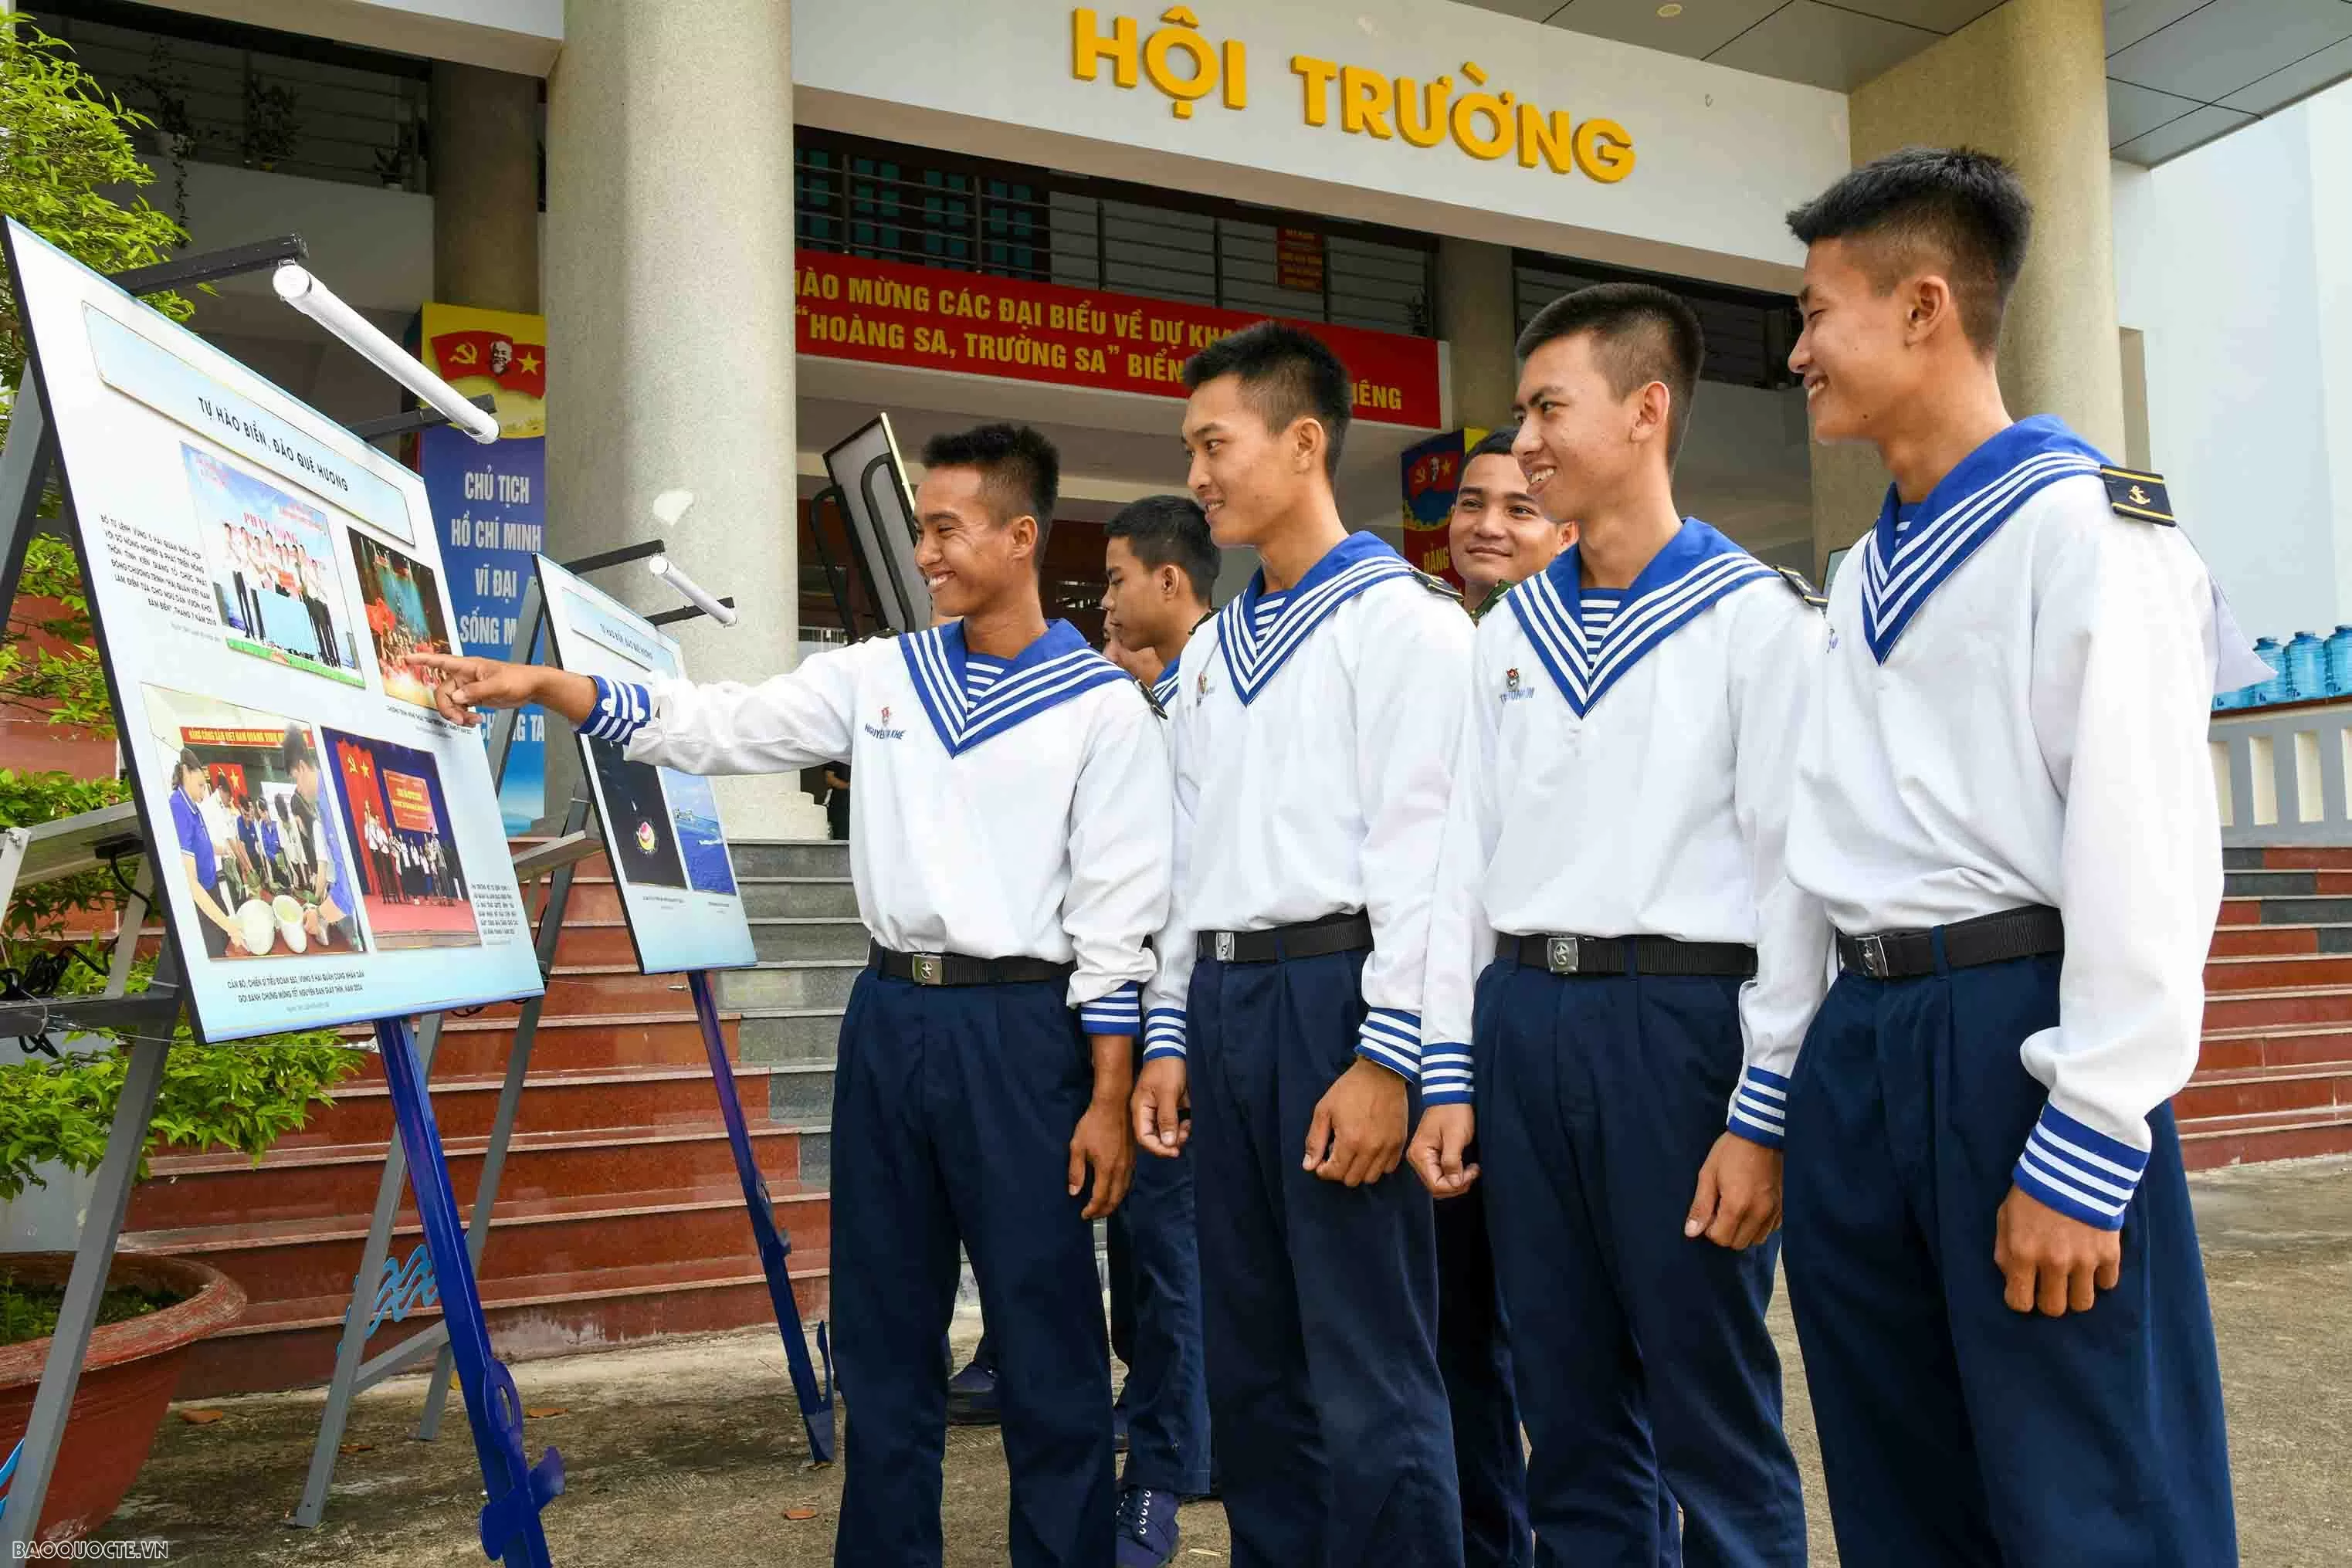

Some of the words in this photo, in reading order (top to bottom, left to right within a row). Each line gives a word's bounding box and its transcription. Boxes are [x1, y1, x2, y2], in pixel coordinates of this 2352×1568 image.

[1072, 5, 1245, 118] HỘI
[1290, 55, 1635, 184] TRƯỜNG
[795, 266, 839, 300] ÀO
[849, 276, 930, 312] MỪNG
[938, 288, 990, 320] CÁC
[999, 297, 1042, 330] ĐẠI
[1049, 300, 1107, 334] BIỂU
[1113, 308, 1144, 340] VỀ
[1150, 318, 1184, 351] DỰ
[913, 327, 957, 359] SA,
[964, 332, 1067, 370] TRƯỜNG
[1351, 378, 1403, 410] IÊNG
[215, 405, 240, 432] HÀO
[297, 452, 315, 474] QUÊ
[464, 463, 494, 501] CHỦ
[497, 474, 530, 509] TỊCH
[475, 516, 500, 550] CHÍ
[503, 522, 542, 552] MINH
[474, 563, 490, 596] VĨ
[493, 568, 518, 605] ĐẠI
[459, 606, 500, 645] SỐNG
[530, 714, 545, 742] TA
